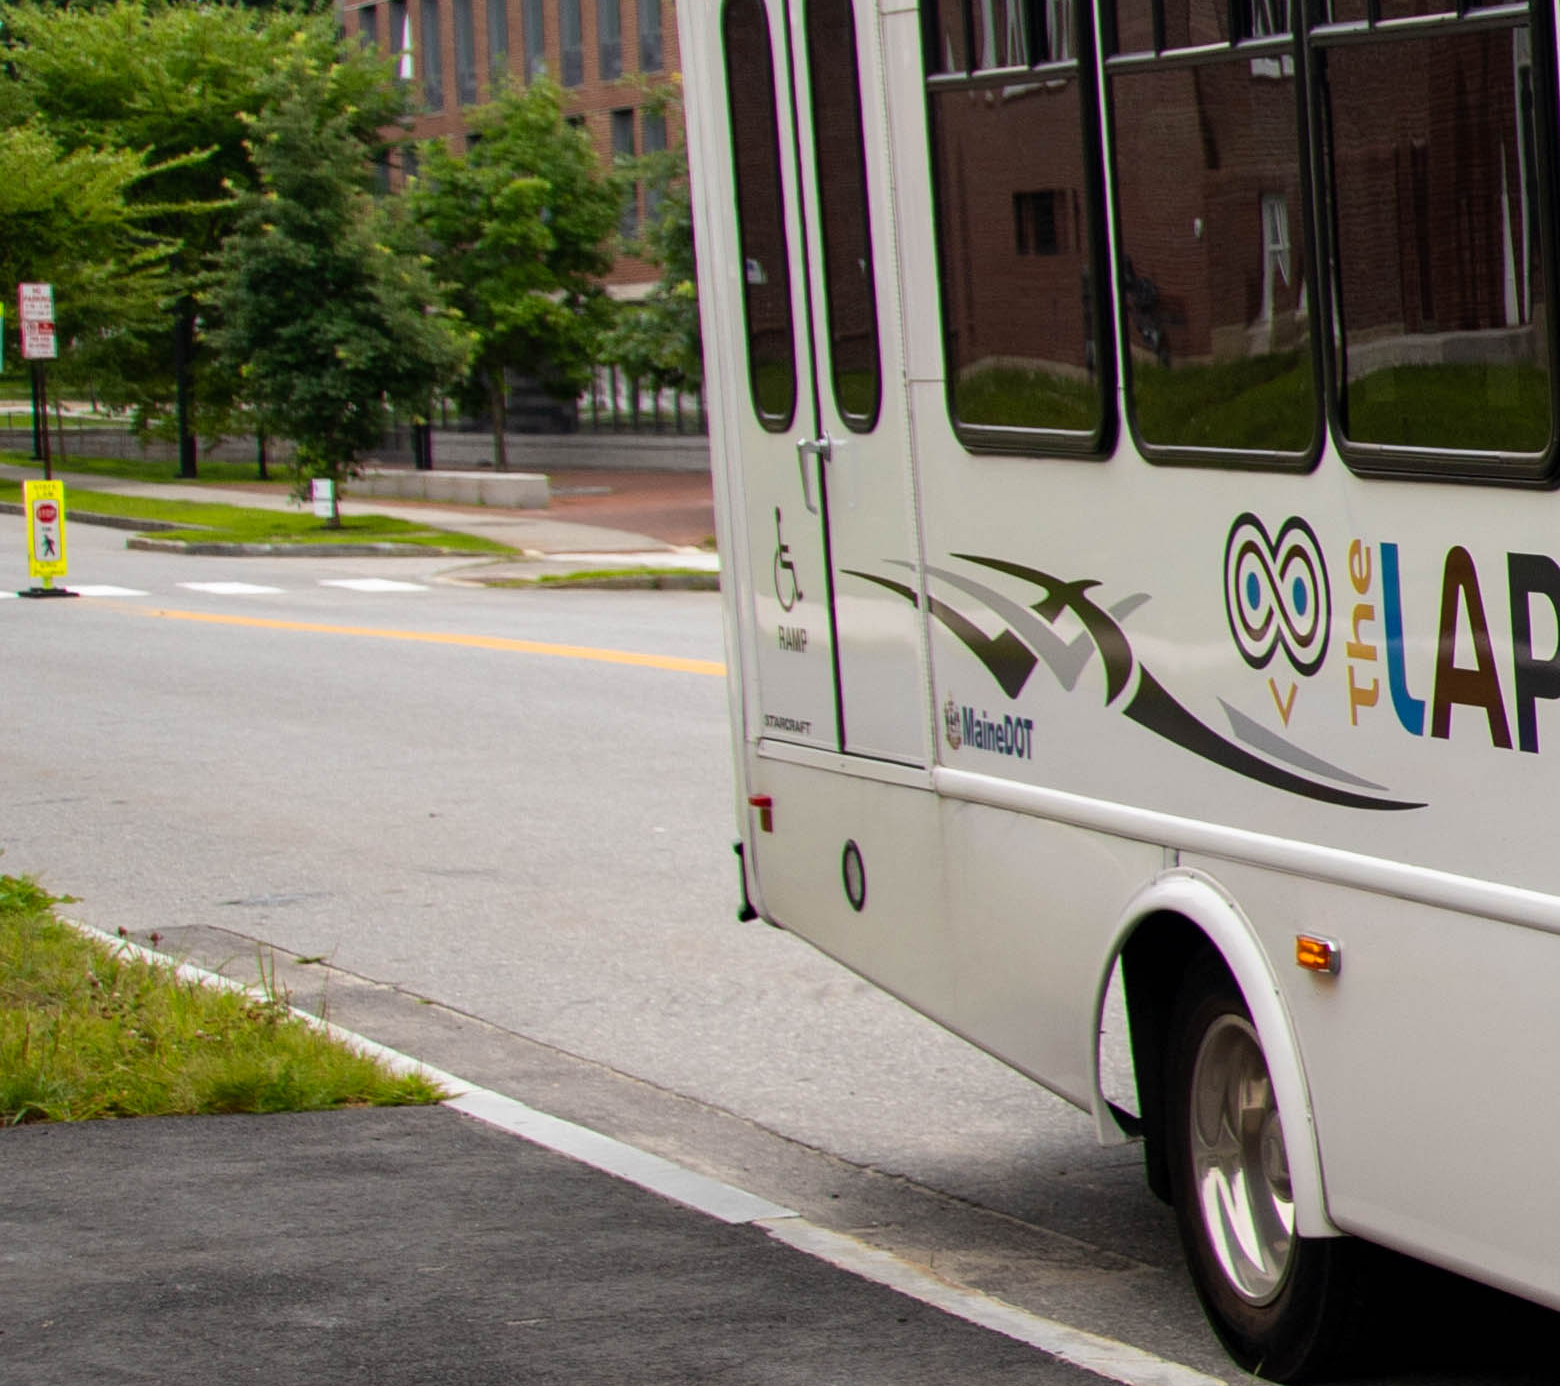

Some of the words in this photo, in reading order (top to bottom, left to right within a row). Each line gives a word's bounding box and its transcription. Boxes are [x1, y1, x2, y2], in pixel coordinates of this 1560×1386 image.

[778, 625, 807, 653] RAMP
[764, 714, 811, 734] STARCRAFT
[962, 706, 1033, 760] MaineDOT
